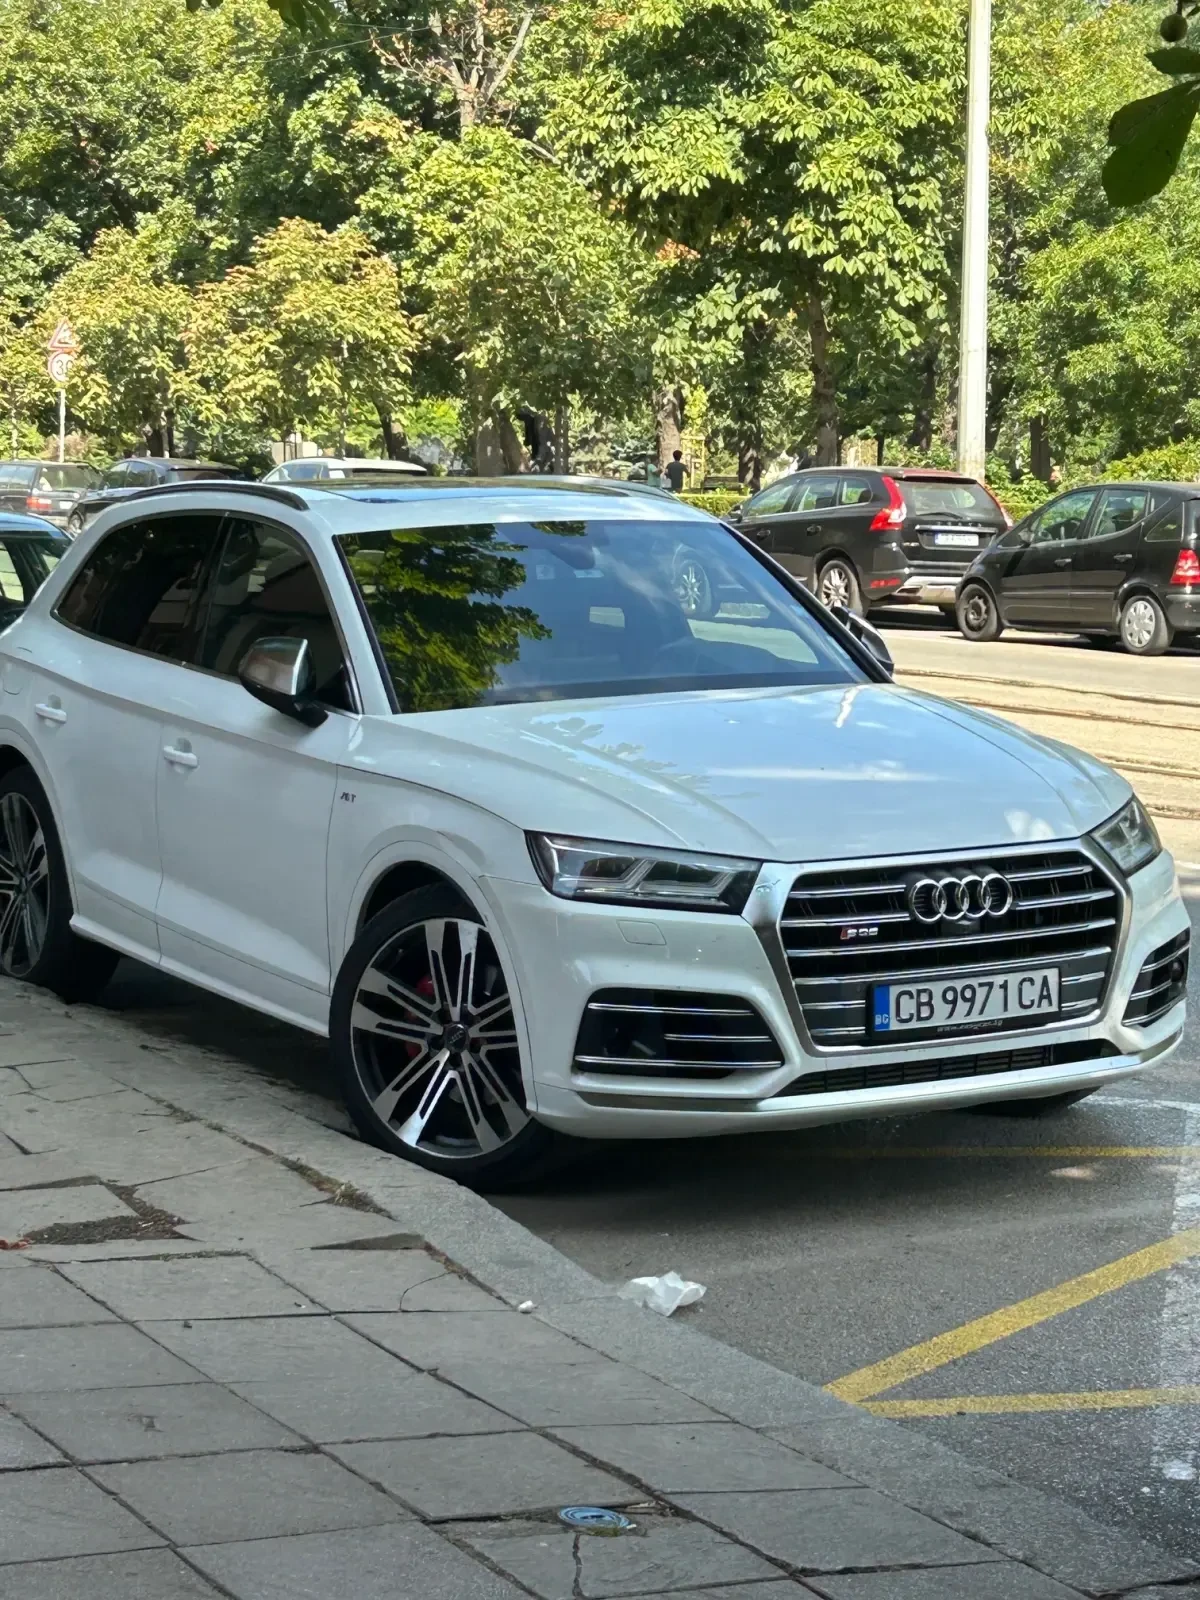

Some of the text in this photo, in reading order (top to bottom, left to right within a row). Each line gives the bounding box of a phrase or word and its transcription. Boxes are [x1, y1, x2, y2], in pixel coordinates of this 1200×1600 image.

[895, 975, 1053, 1024] CB 9971 CA
[874, 1014, 889, 1026] BG
